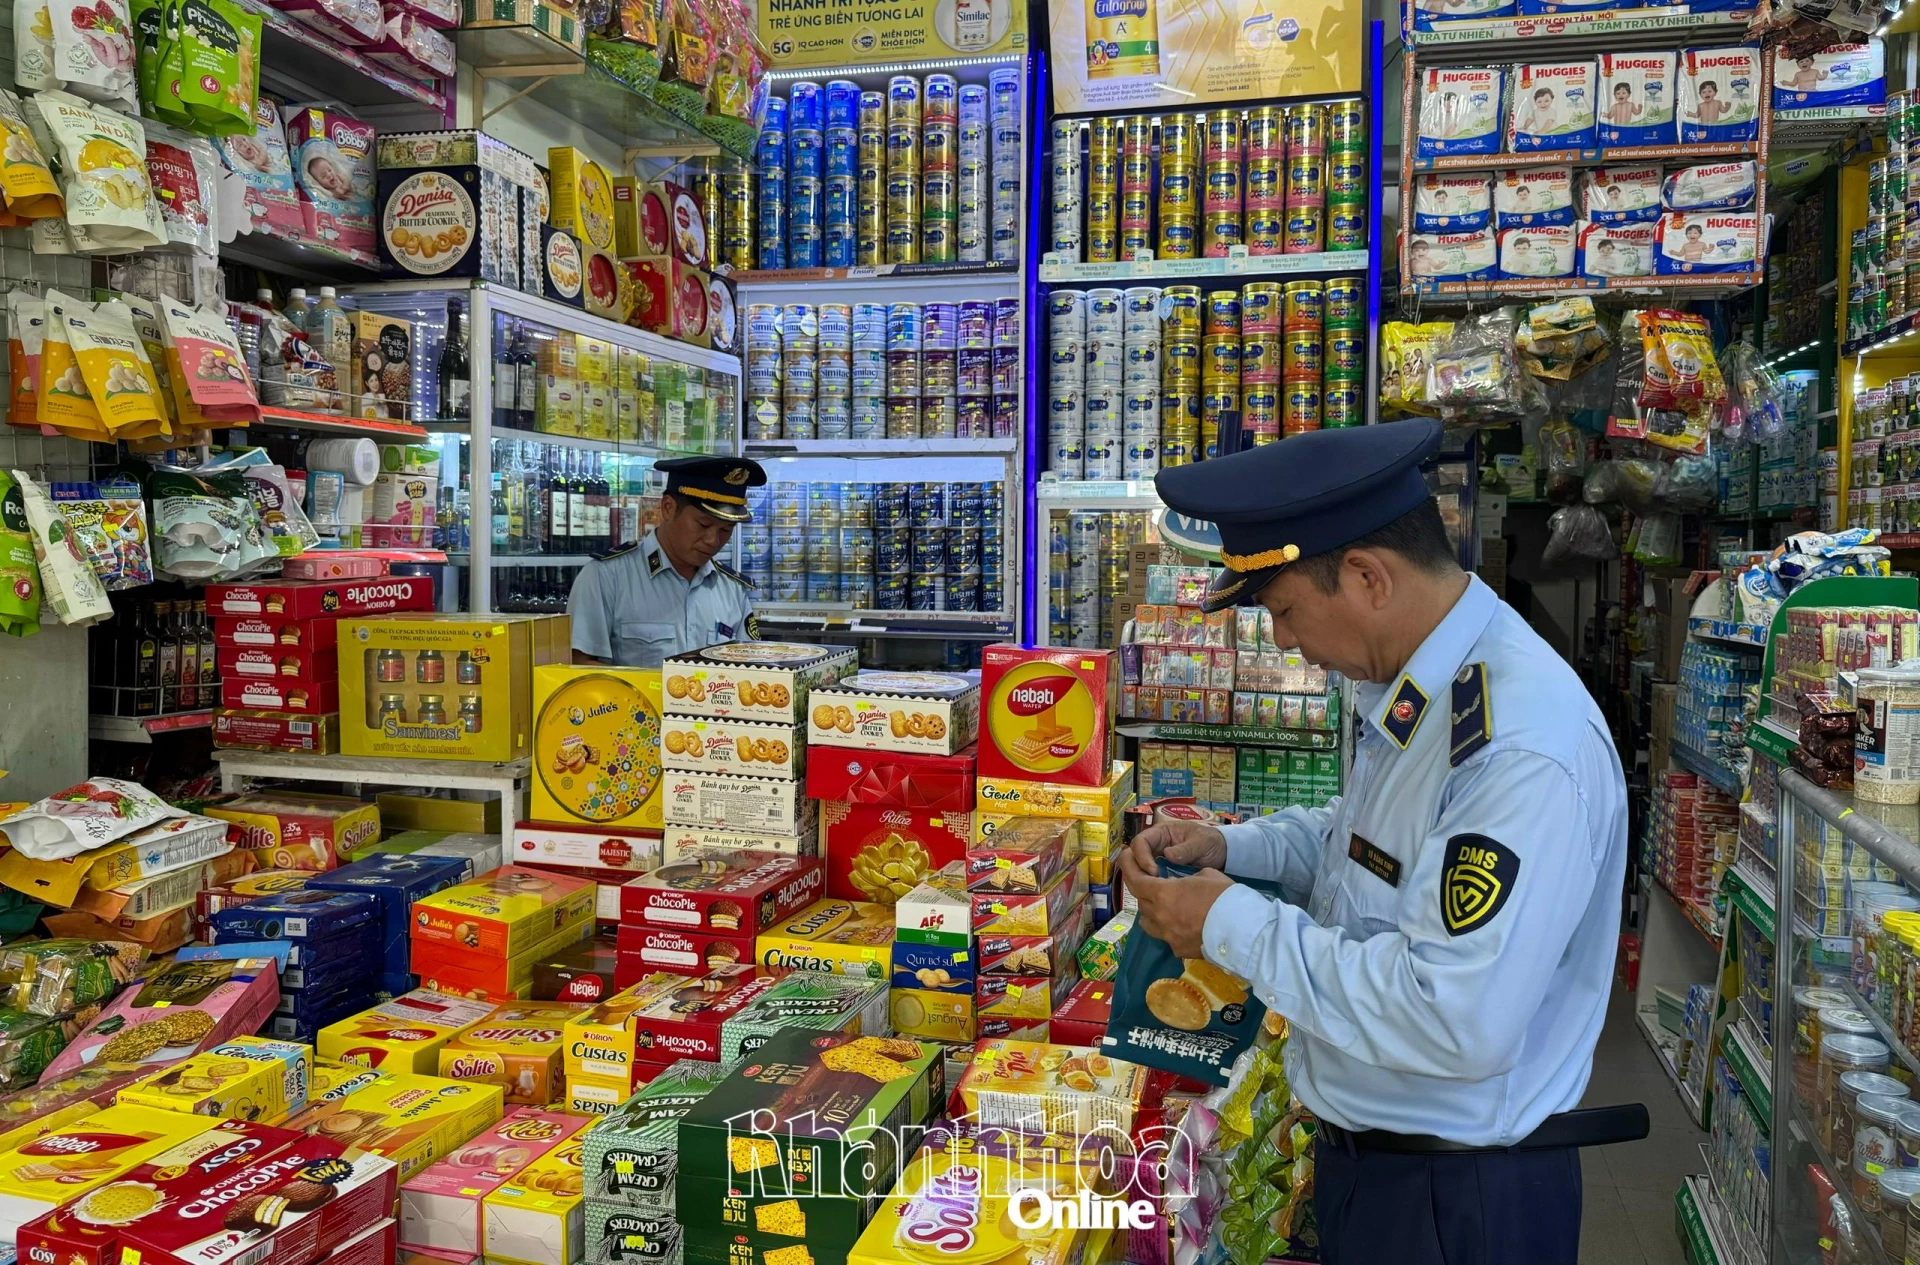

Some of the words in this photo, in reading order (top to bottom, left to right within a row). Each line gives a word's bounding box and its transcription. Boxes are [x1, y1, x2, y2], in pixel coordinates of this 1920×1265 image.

[905, 7, 924, 18] LAI
[956, 11, 990, 22] Similac
[773, 41, 792, 54] 5G
[1144, 41, 1152, 55] 4
[1616, 60, 1665, 70] HUGGIES
[1700, 56, 1750, 68] HUGGIES
[1443, 72, 1491, 82] HUGGIES
[1536, 66, 1586, 78] HUGGIES
[335, 127, 369, 150] Bobby
[1524, 172, 1566, 182] HUGGIES
[1613, 169, 1657, 183] HUGGIES
[1696, 164, 1742, 178] HUGGIES
[1443, 178, 1485, 188] HUGGIES
[396, 186, 457, 218] Danisa
[399, 217, 426, 226] BUTTER
[428, 216, 460, 226] COOKIES
[1606, 229, 1650, 240] HUGGIES
[1672, 262, 1681, 270] XL
[820, 322, 848, 332] Similac
[821, 368, 850, 378] Similac
[1672, 360, 1696, 372] Canxi
[820, 415, 848, 424] Similac
[878, 498, 905, 508] Ensure
[912, 497, 937, 507] Ensure
[226, 590, 258, 601] ChocoPie
[347, 584, 413, 600] ChocoPie
[879, 589, 905, 599] Ensure
[949, 589, 976, 599] Ensure
[236, 622, 271, 633] ChocoPie
[238, 652, 273, 662] ChocoPie
[244, 684, 279, 695] ChocoPie
[706, 680, 736, 694] Danisa
[1012, 688, 1054, 704] nabati
[588, 702, 618, 718] Julie's
[856, 710, 888, 724] Danisa
[385, 718, 461, 740] Sanvinest
[862, 724, 883, 732] BUTTER
[1232, 730, 1274, 740] VINAMILK
[1276, 732, 1299, 740] 100%
[705, 736, 734, 750] Danisa
[673, 784, 696, 794] Danisa
[700, 780, 718, 789] Bánh
[719, 782, 732, 792] quy
[732, 781, 740, 790] bơ
[740, 784, 762, 794] Danisa
[884, 823, 907, 831] GOLD
[341, 820, 378, 852] Solite
[676, 838, 698, 848] Danisa
[703, 834, 720, 844] Bánh
[721, 837, 733, 846] quy
[734, 836, 742, 845] bơ
[743, 838, 764, 848] Danisa
[600, 848, 632, 858] MAJESTIC
[1458, 846, 1498, 870] DMS
[972, 857, 996, 870] Magic
[718, 857, 796, 893] ChocoPie
[778, 868, 821, 904] ChocoPie
[649, 895, 696, 910] ChocoPie
[430, 918, 454, 930] Julie's
[786, 903, 850, 936] Custas
[920, 914, 944, 928] AFC
[646, 935, 693, 951] ChocoPie
[985, 940, 1010, 952] Magic
[1080, 944, 1092, 956] LOTTE
[764, 949, 834, 972] Custas
[906, 954, 925, 967] QUY
[928, 955, 942, 966] BƠ
[570, 982, 600, 997] nabati
[982, 980, 1008, 991] Magic
[928, 1012, 968, 1030] August
[984, 1021, 1008, 1032] Magic
[471, 1028, 564, 1044] Solite
[590, 1034, 615, 1042] ORION
[657, 1034, 707, 1052] ChocoPie
[572, 1042, 627, 1064] Custas
[451, 1058, 497, 1079] Solite
[754, 1062, 789, 1083] KEN
[823, 1109, 850, 1124] 10
[38, 1136, 101, 1154] nabati
[188, 1142, 219, 1159] Marie
[944, 1138, 975, 1154] 16
[198, 1138, 262, 1174] COSY
[607, 1152, 658, 1167] CRACKERS
[788, 1160, 812, 1174] KEN
[215, 1166, 258, 1190] ORION
[618, 1174, 658, 1188] CREAM
[178, 1154, 306, 1218] ChocoPie
[723, 1197, 747, 1210] KEN
[908, 1166, 979, 1252] Solite
[610, 1220, 660, 1234] CRACKERS
[29, 1247, 57, 1264] COSY
[199, 1245, 224, 1260] 10
[729, 1244, 753, 1256] KEN
